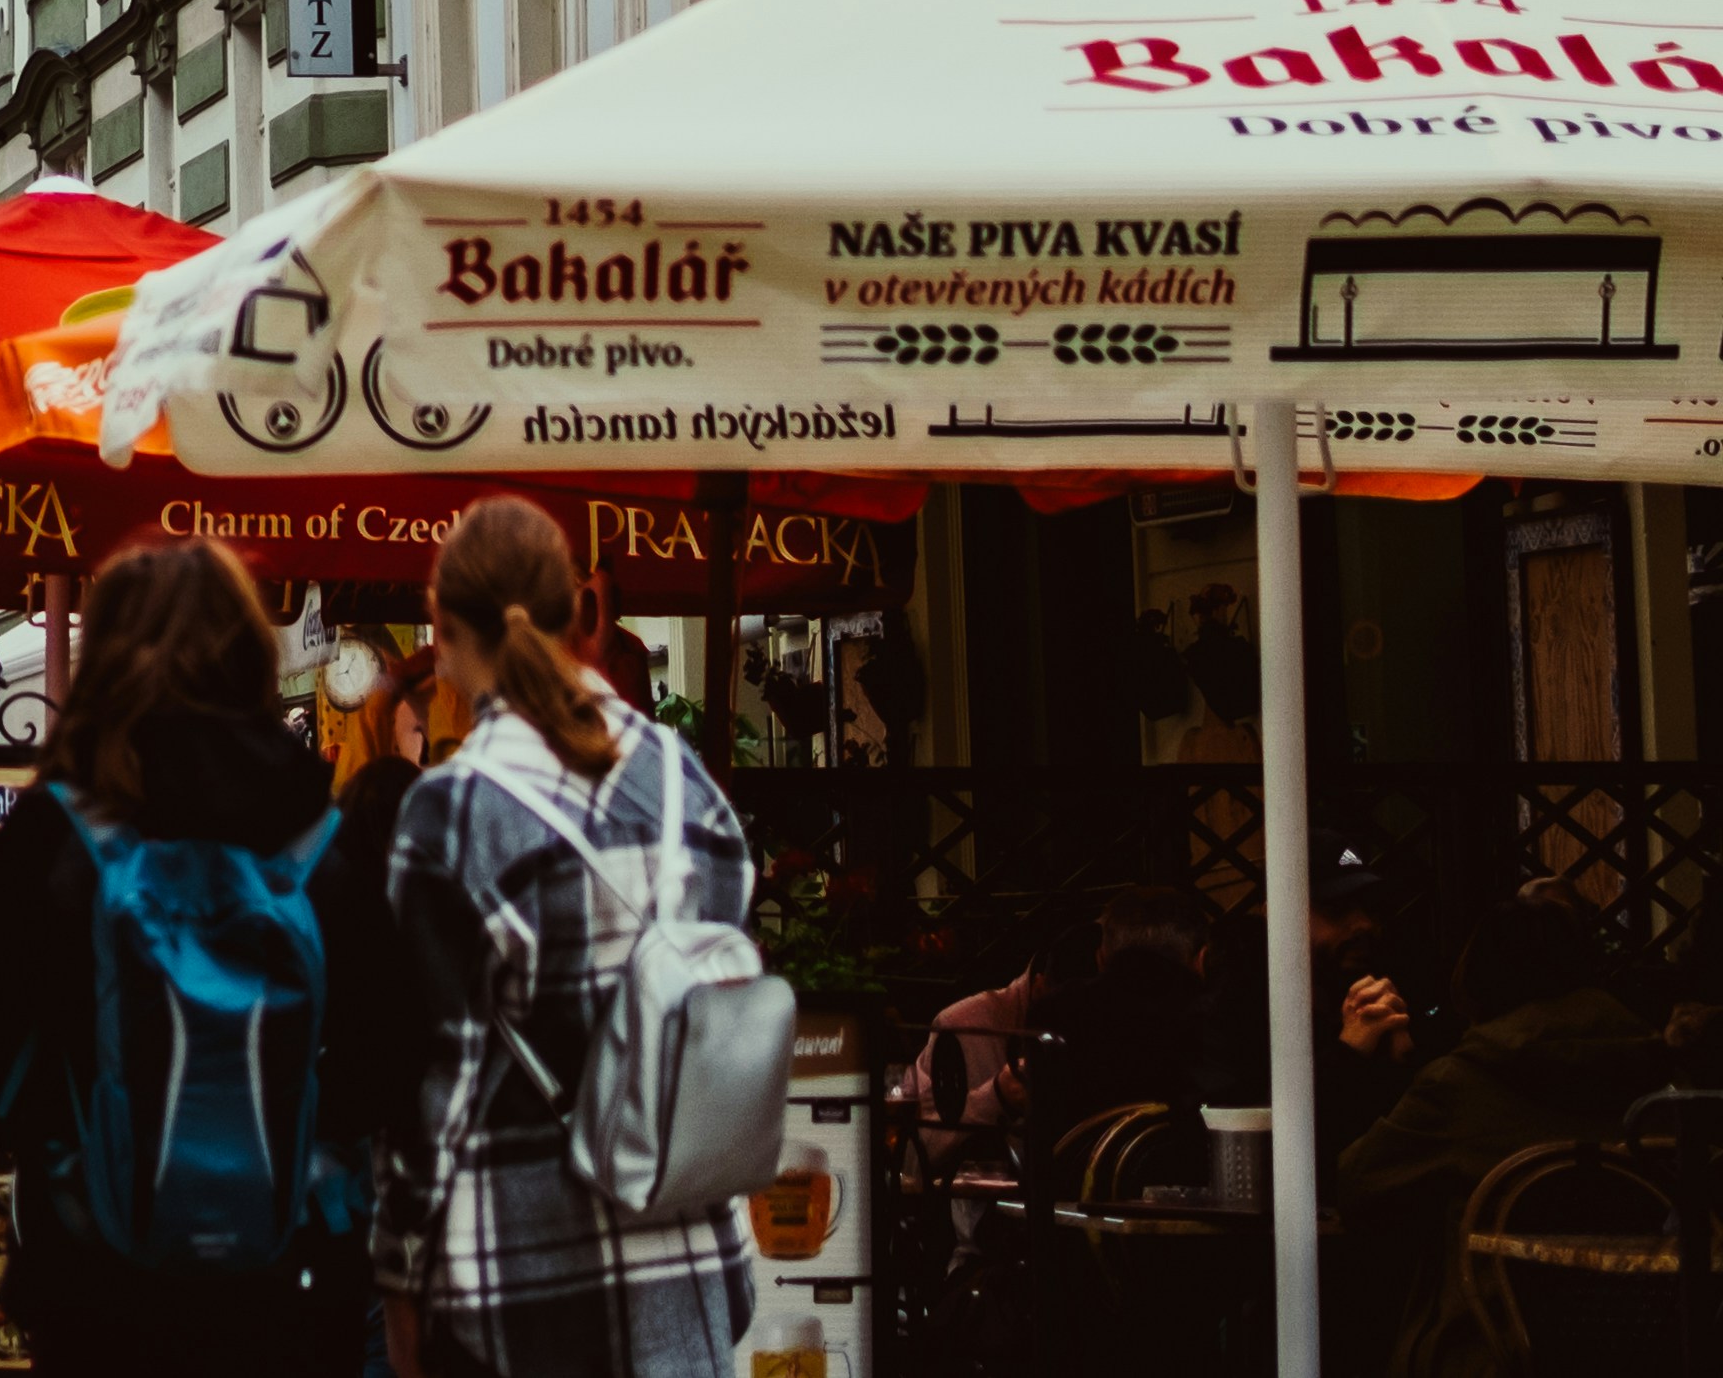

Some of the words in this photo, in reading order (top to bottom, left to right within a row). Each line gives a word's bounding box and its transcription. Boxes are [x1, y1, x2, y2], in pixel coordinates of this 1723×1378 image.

[1220, 105, 1502, 137] Dobré
[544, 198, 645, 227] 1454
[827, 211, 956, 258] NAŠE
[967, 219, 1084, 258] PIVA
[1094, 210, 1243, 256] KVASÍ
[436, 237, 751, 305] Bakalář
[824, 276, 848, 306] v
[857, 267, 1086, 316] otevřených
[1097, 266, 1236, 306] kádích
[487, 333, 595, 369] Dobré
[605, 333, 694, 376] pivo.
[161, 500, 293, 538] Charm
[305, 502, 346, 540] of
